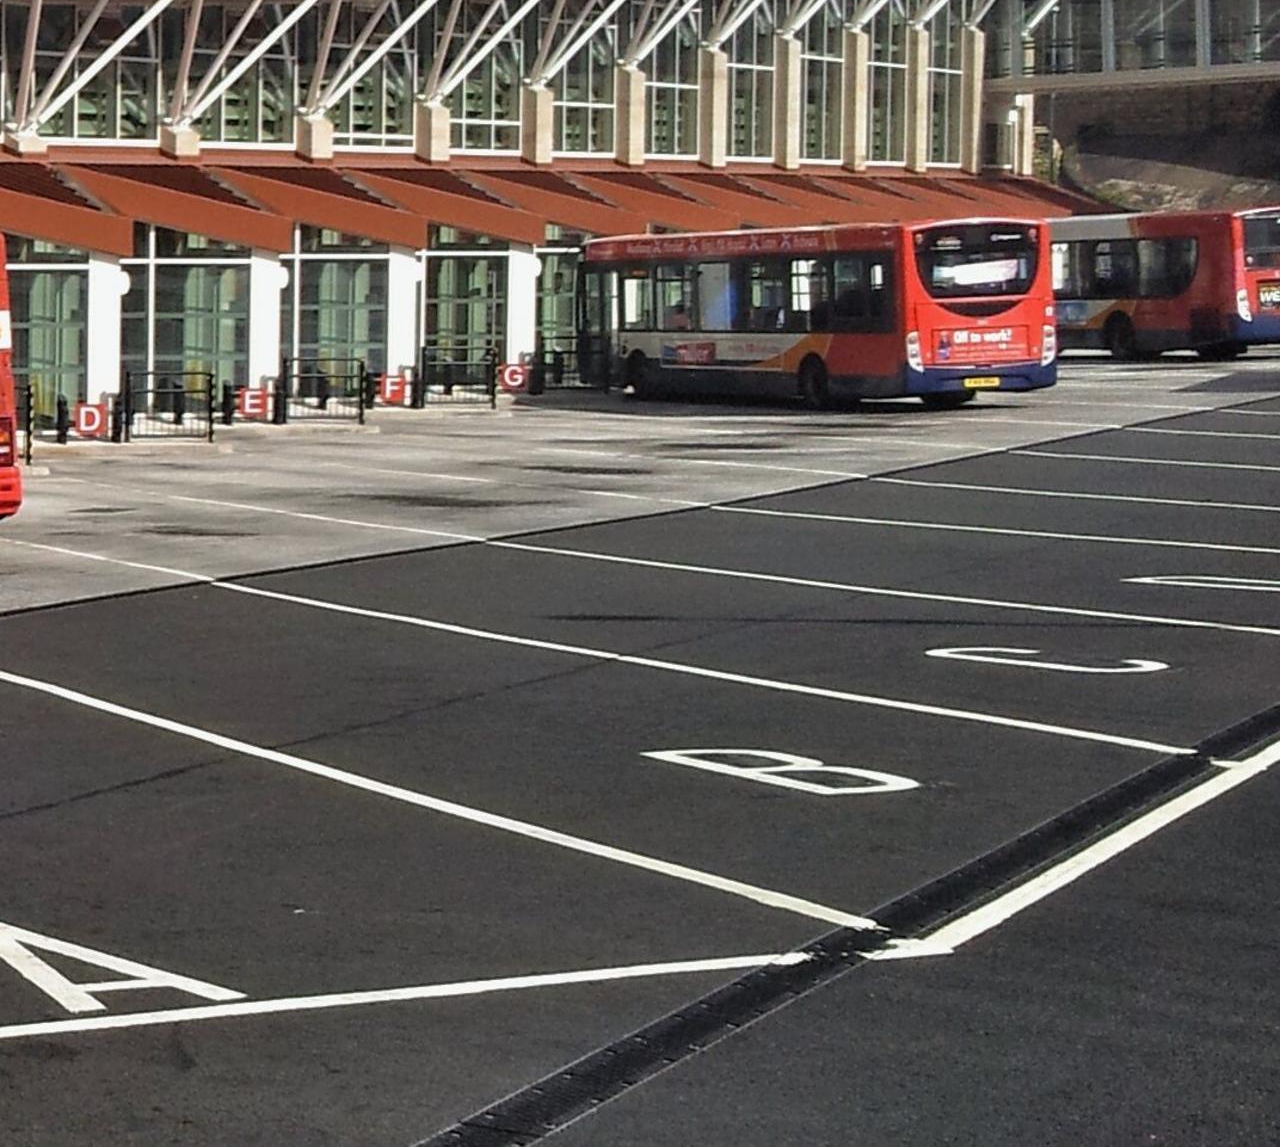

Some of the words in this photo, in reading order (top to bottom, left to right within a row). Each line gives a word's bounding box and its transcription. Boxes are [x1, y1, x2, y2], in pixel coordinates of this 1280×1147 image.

[504, 365, 524, 386] G
[385, 377, 401, 398] F
[244, 390, 262, 413] E
[80, 406, 101, 431] D
[640, 749, 920, 794] B
